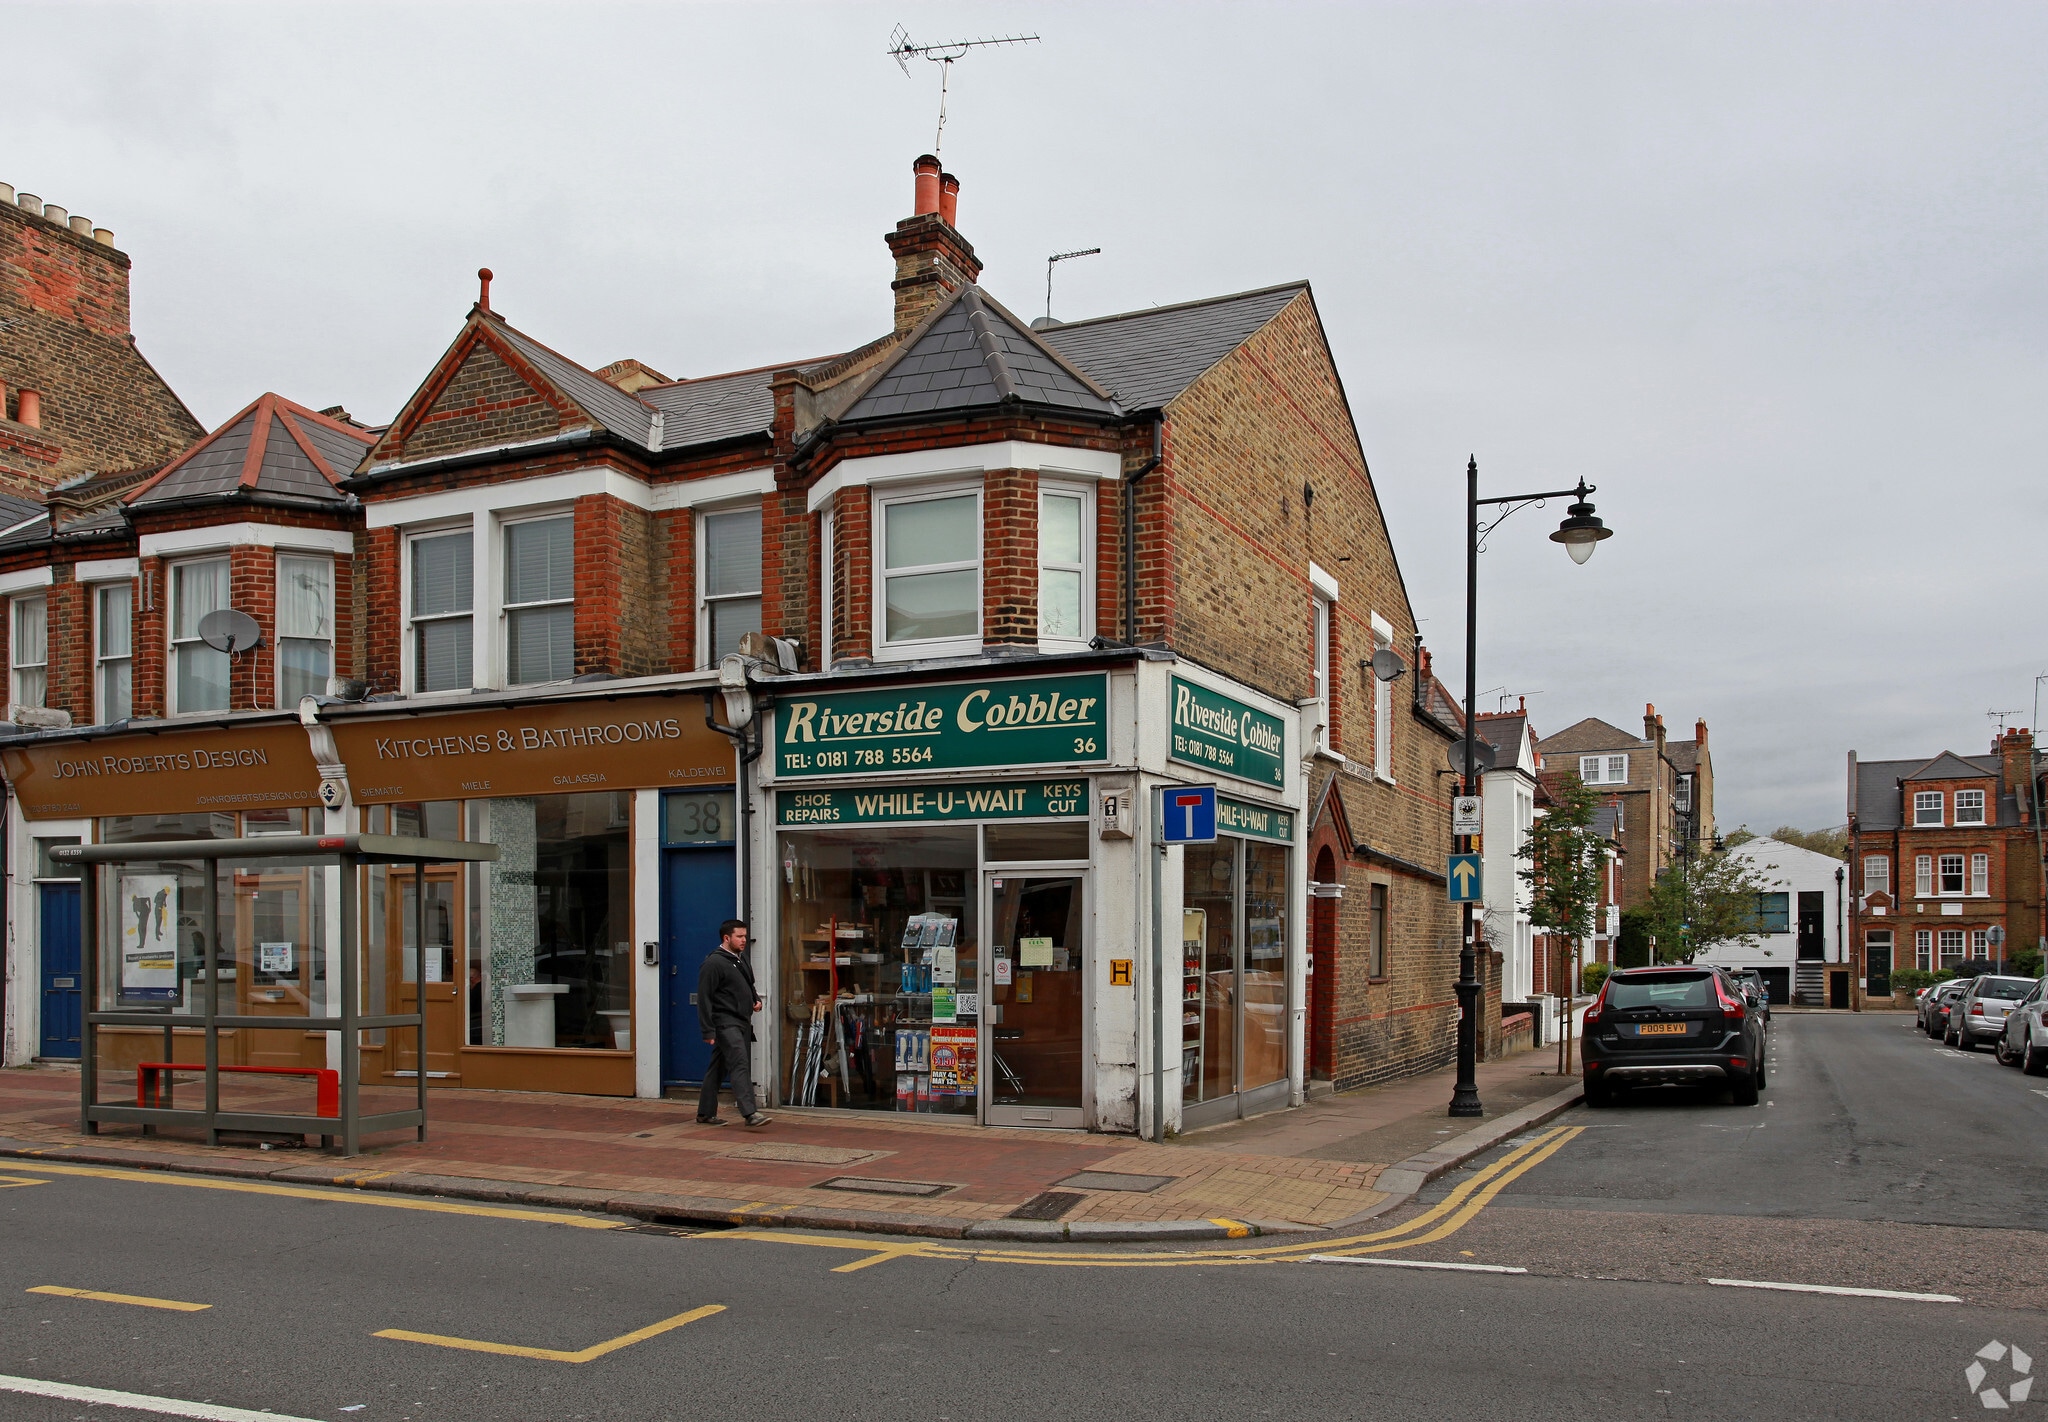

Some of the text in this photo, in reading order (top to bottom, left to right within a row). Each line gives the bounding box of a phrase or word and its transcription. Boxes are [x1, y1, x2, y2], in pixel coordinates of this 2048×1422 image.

[784, 689, 1097, 744] Riverside Cobbler
[1174, 684, 1281, 753] Riverside Cobbler
[375, 718, 681, 760] KITCHENS & BATHROOMS
[1073, 737, 1097, 754] 36
[784, 746, 933, 769] TEL: 0181 788 5564
[1174, 734, 1234, 767] TEL: 0181 788 5564
[52, 748, 268, 779] JOHN ROBERTS DESIGN
[553, 773, 608, 785] GALASSIA
[668, 766, 727, 778] KALDEWEI
[1274, 767, 1282, 781] 36
[360, 786, 404, 798] SIEMATIC
[461, 780, 492, 791] MIELE
[1043, 784, 1082, 798] KEYS
[794, 794, 832, 807] SHOE
[854, 788, 1027, 817] WHILE-U-WAIT
[1047, 799, 1077, 813] CUT
[683, 801, 721, 836] 38
[786, 807, 840, 822] REPAIRS
[1277, 814, 1289, 826] KEYS
[1278, 827, 1288, 838] CUT
[1113, 962, 1129, 983] H
[1667, 1023, 1685, 1032] EVV
[932, 1077, 946, 1085] MAY
